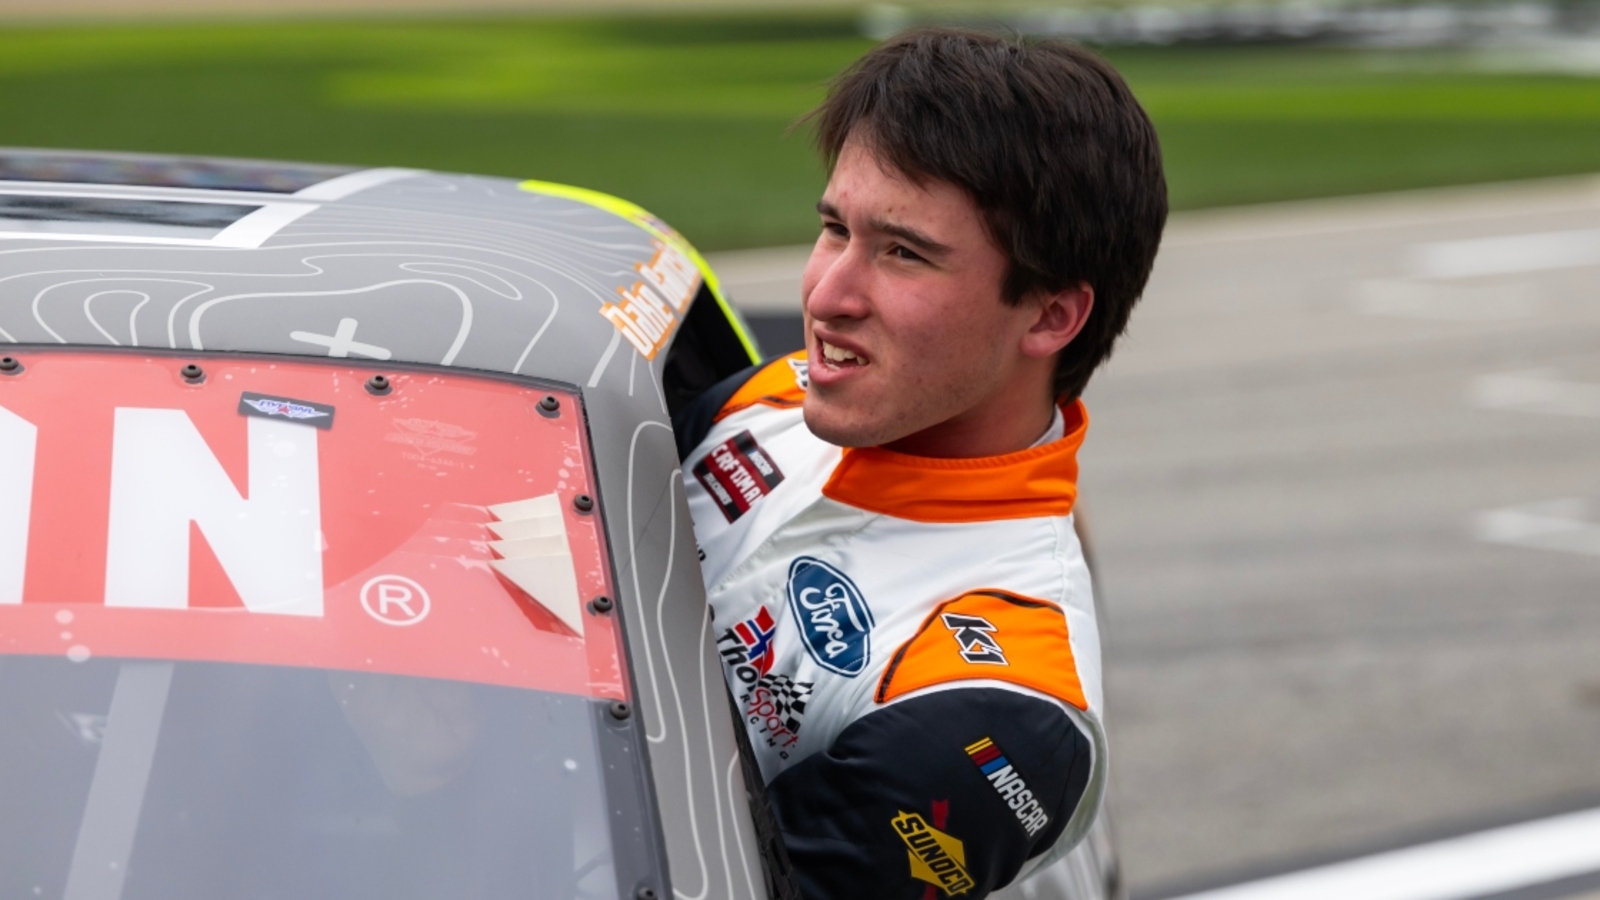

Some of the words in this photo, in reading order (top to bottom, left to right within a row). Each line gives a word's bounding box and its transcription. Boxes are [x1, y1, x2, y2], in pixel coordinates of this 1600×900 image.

[800, 582, 866, 659] Ford
[740, 693, 789, 760] RCING
[986, 764, 1050, 838] NASCAR
[893, 813, 973, 896] SUNOCO
